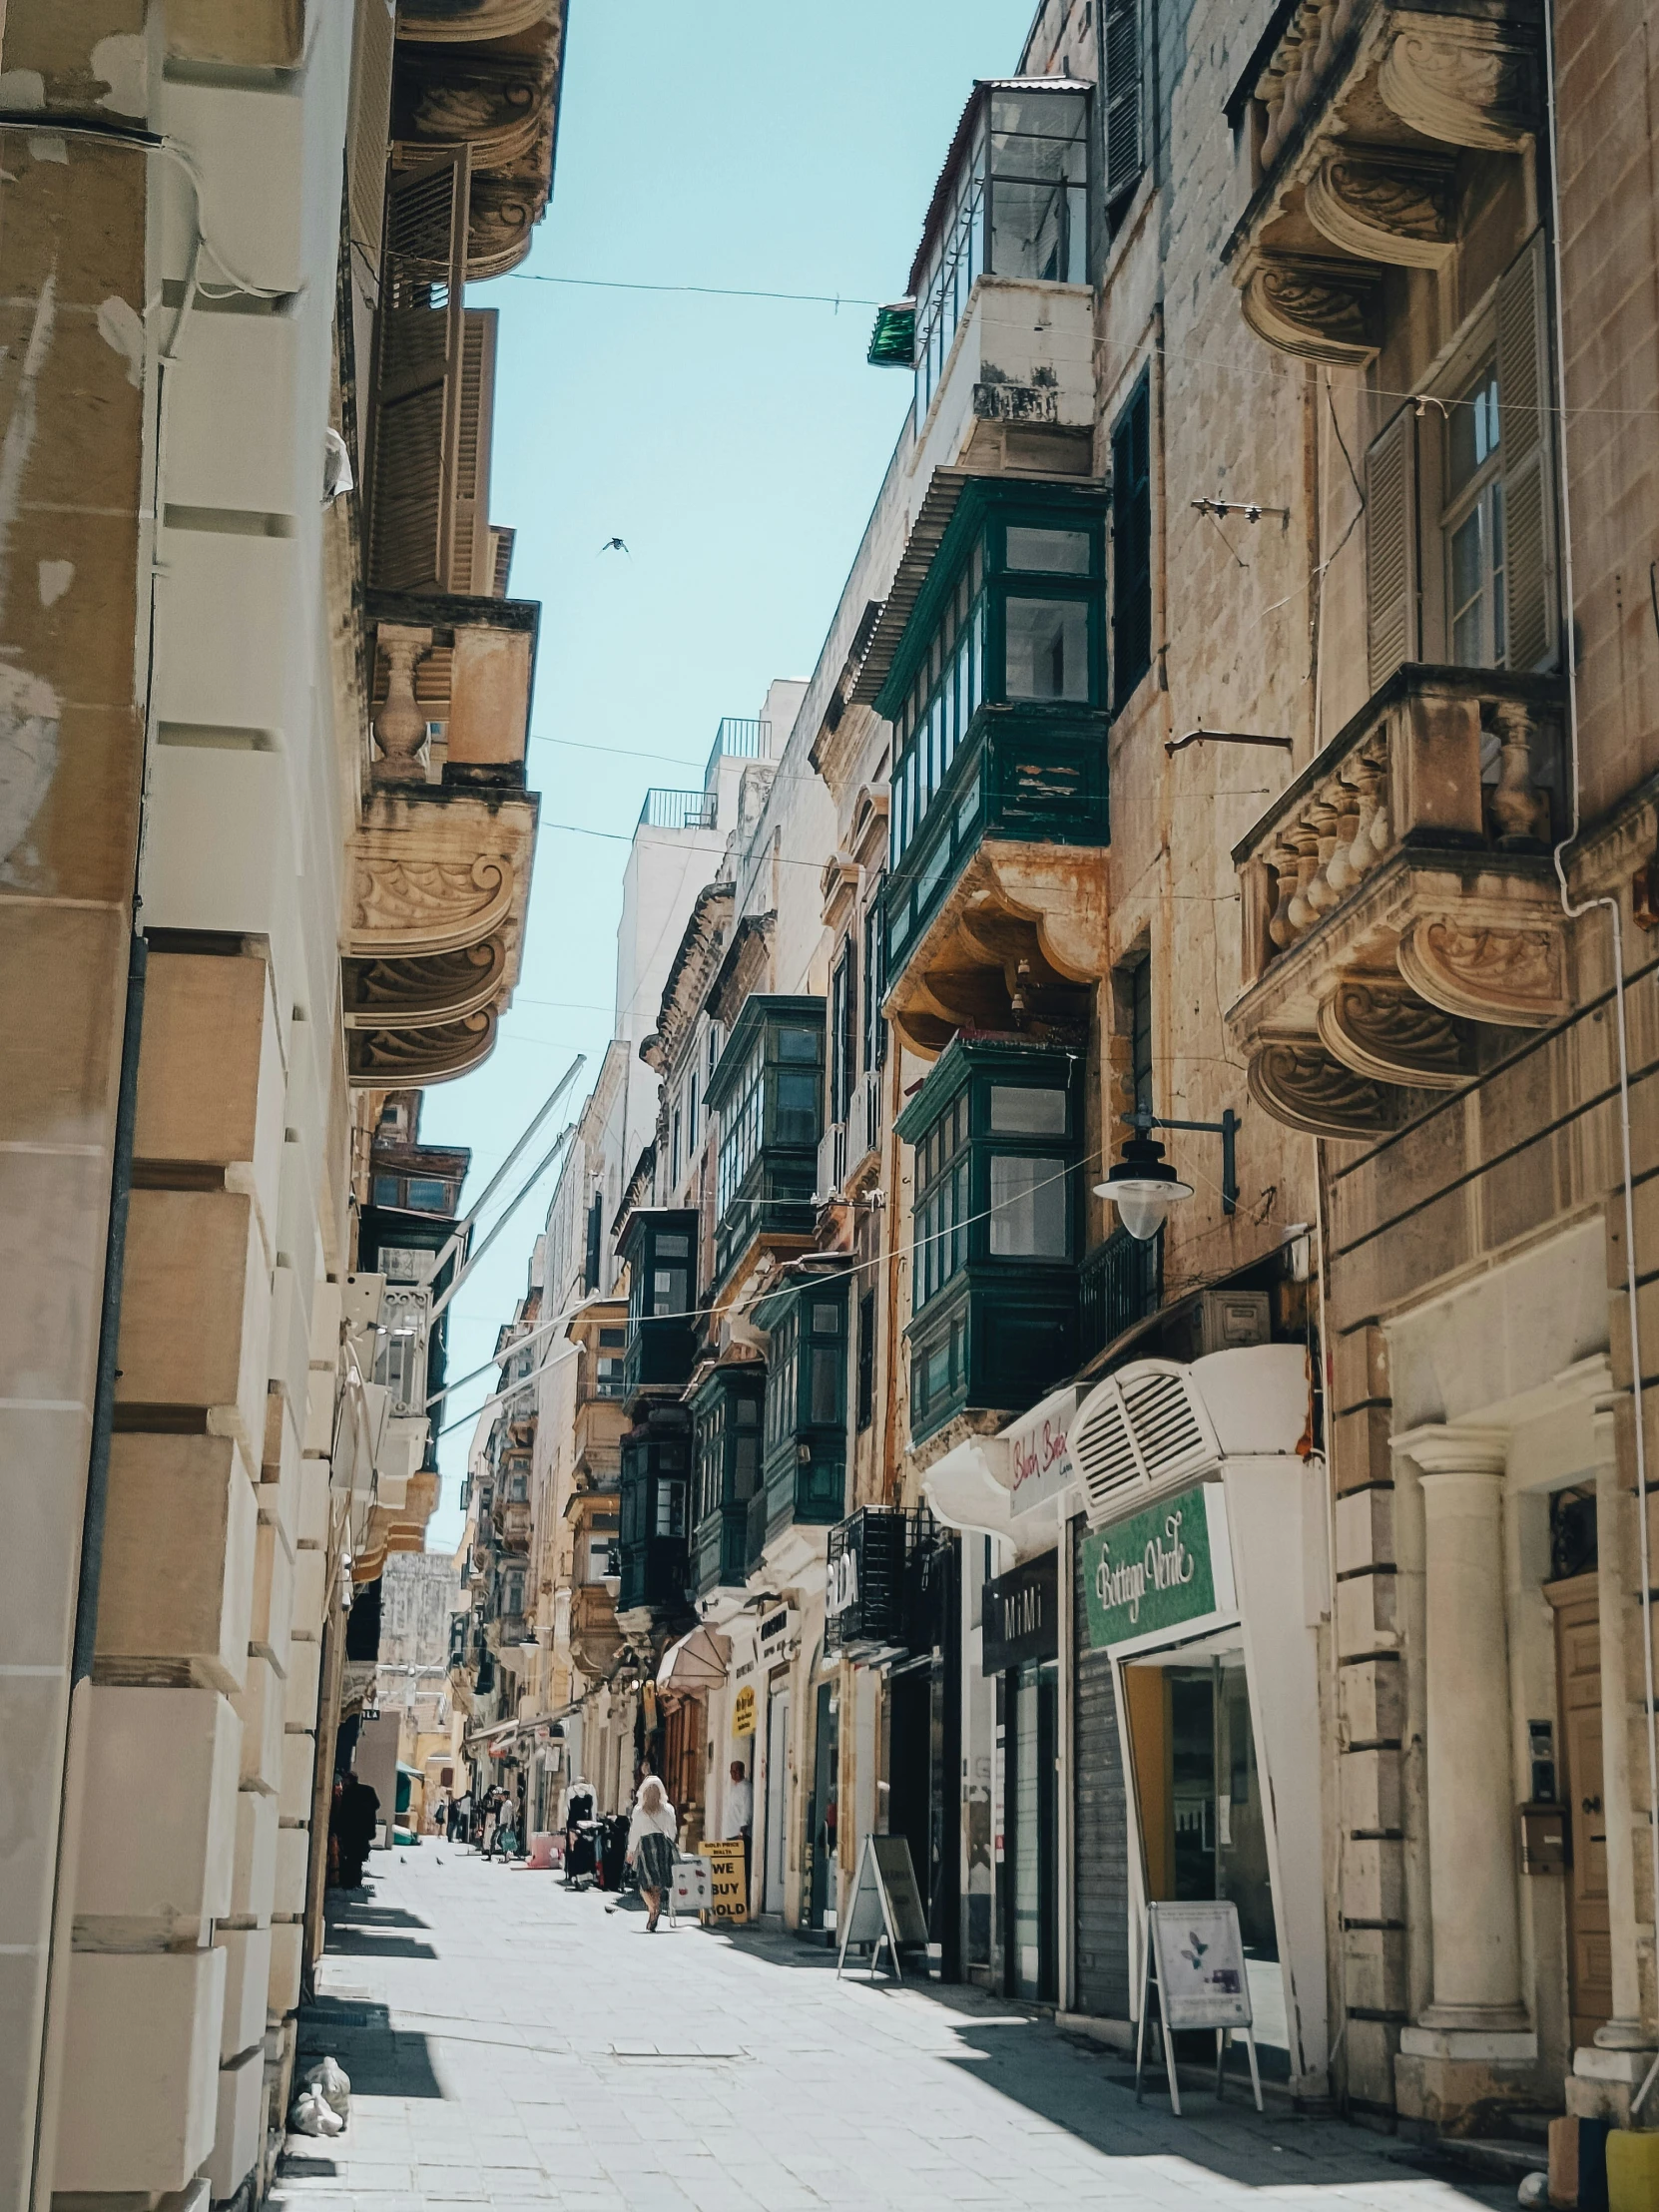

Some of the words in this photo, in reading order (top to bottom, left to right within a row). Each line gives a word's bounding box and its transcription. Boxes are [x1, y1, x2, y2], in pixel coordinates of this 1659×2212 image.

[1096, 1542, 1145, 1623] Bottega
[1145, 1510, 1194, 1590] Verde
[712, 1863, 735, 1875] WE
[712, 1883, 740, 1896] BUY
[713, 1903, 746, 1916] OLD
